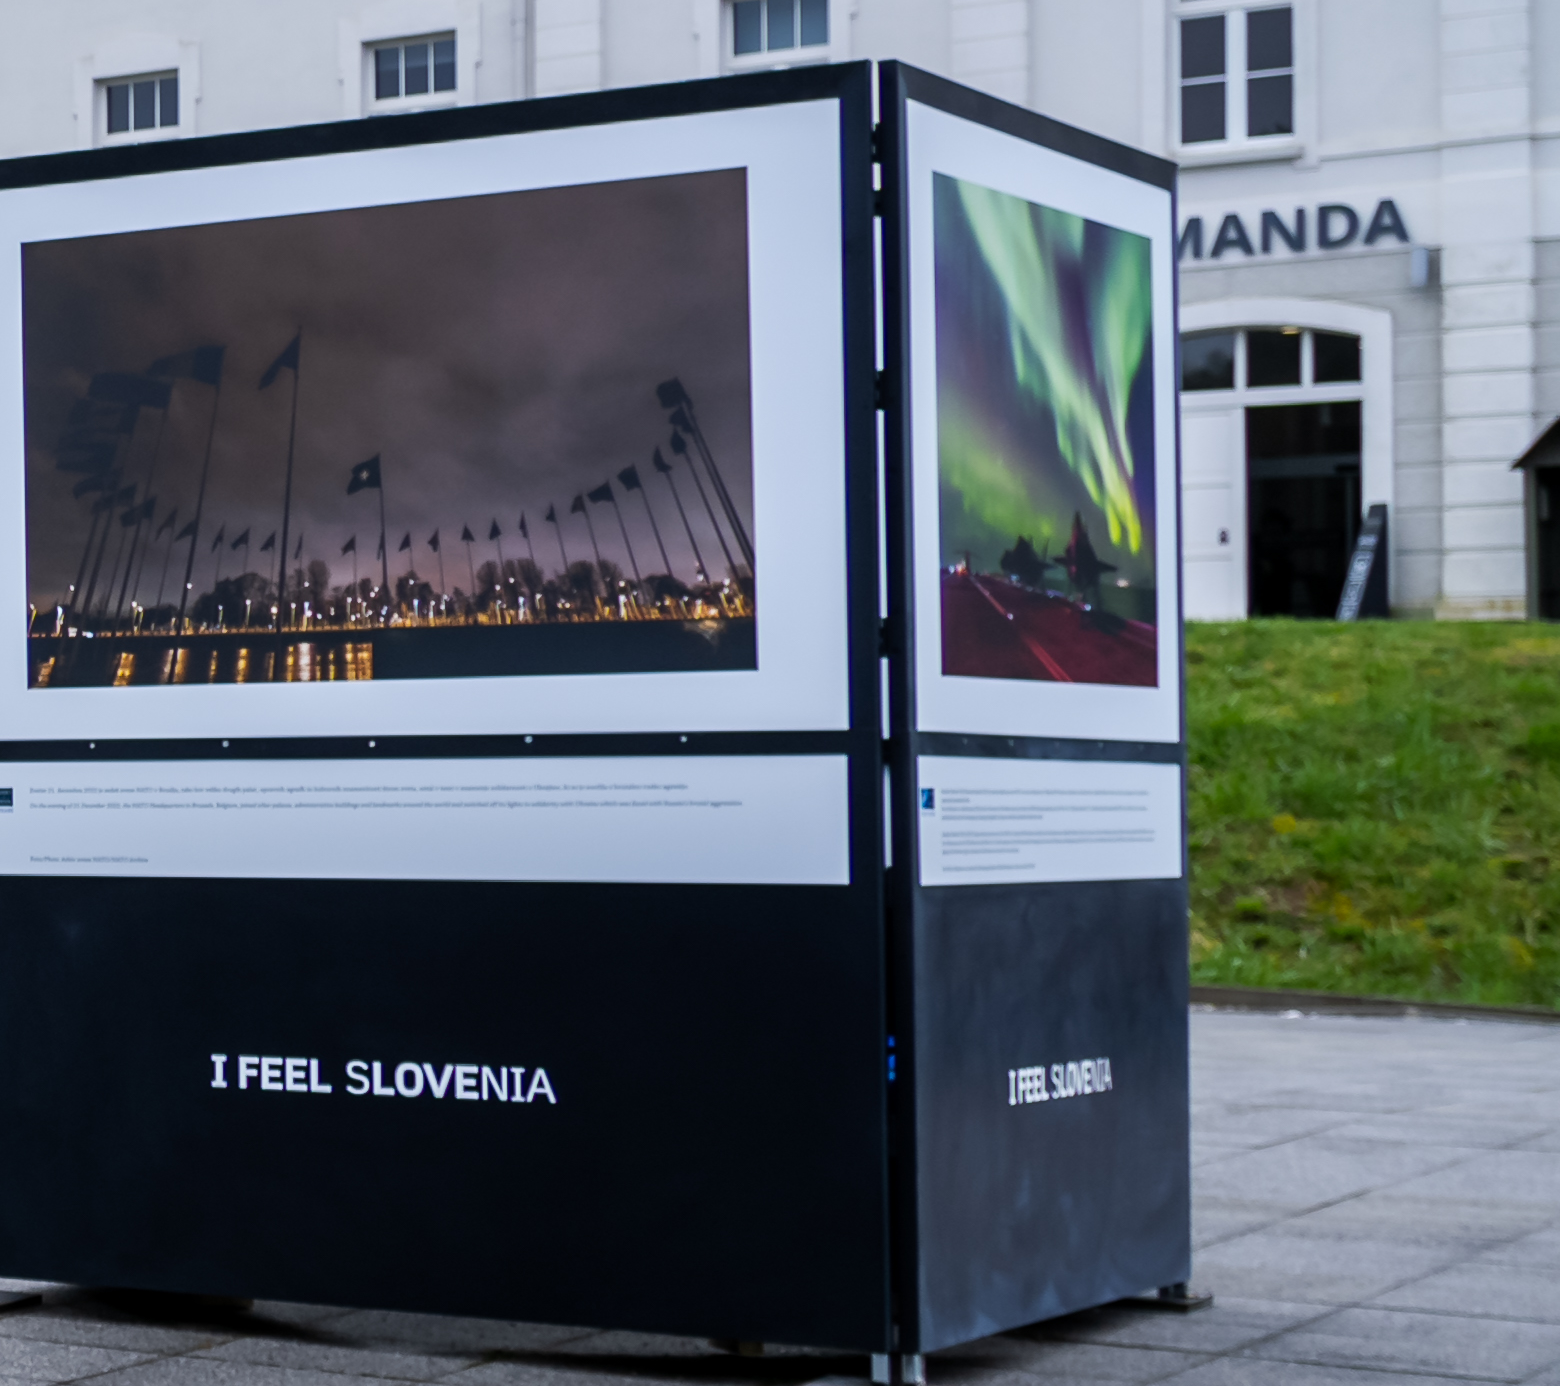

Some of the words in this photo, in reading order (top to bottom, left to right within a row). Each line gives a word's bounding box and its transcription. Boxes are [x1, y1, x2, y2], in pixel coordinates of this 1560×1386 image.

[210, 1054, 227, 1088] I
[238, 1055, 332, 1094] FEEL
[345, 1059, 557, 1104] SLOVENIA
